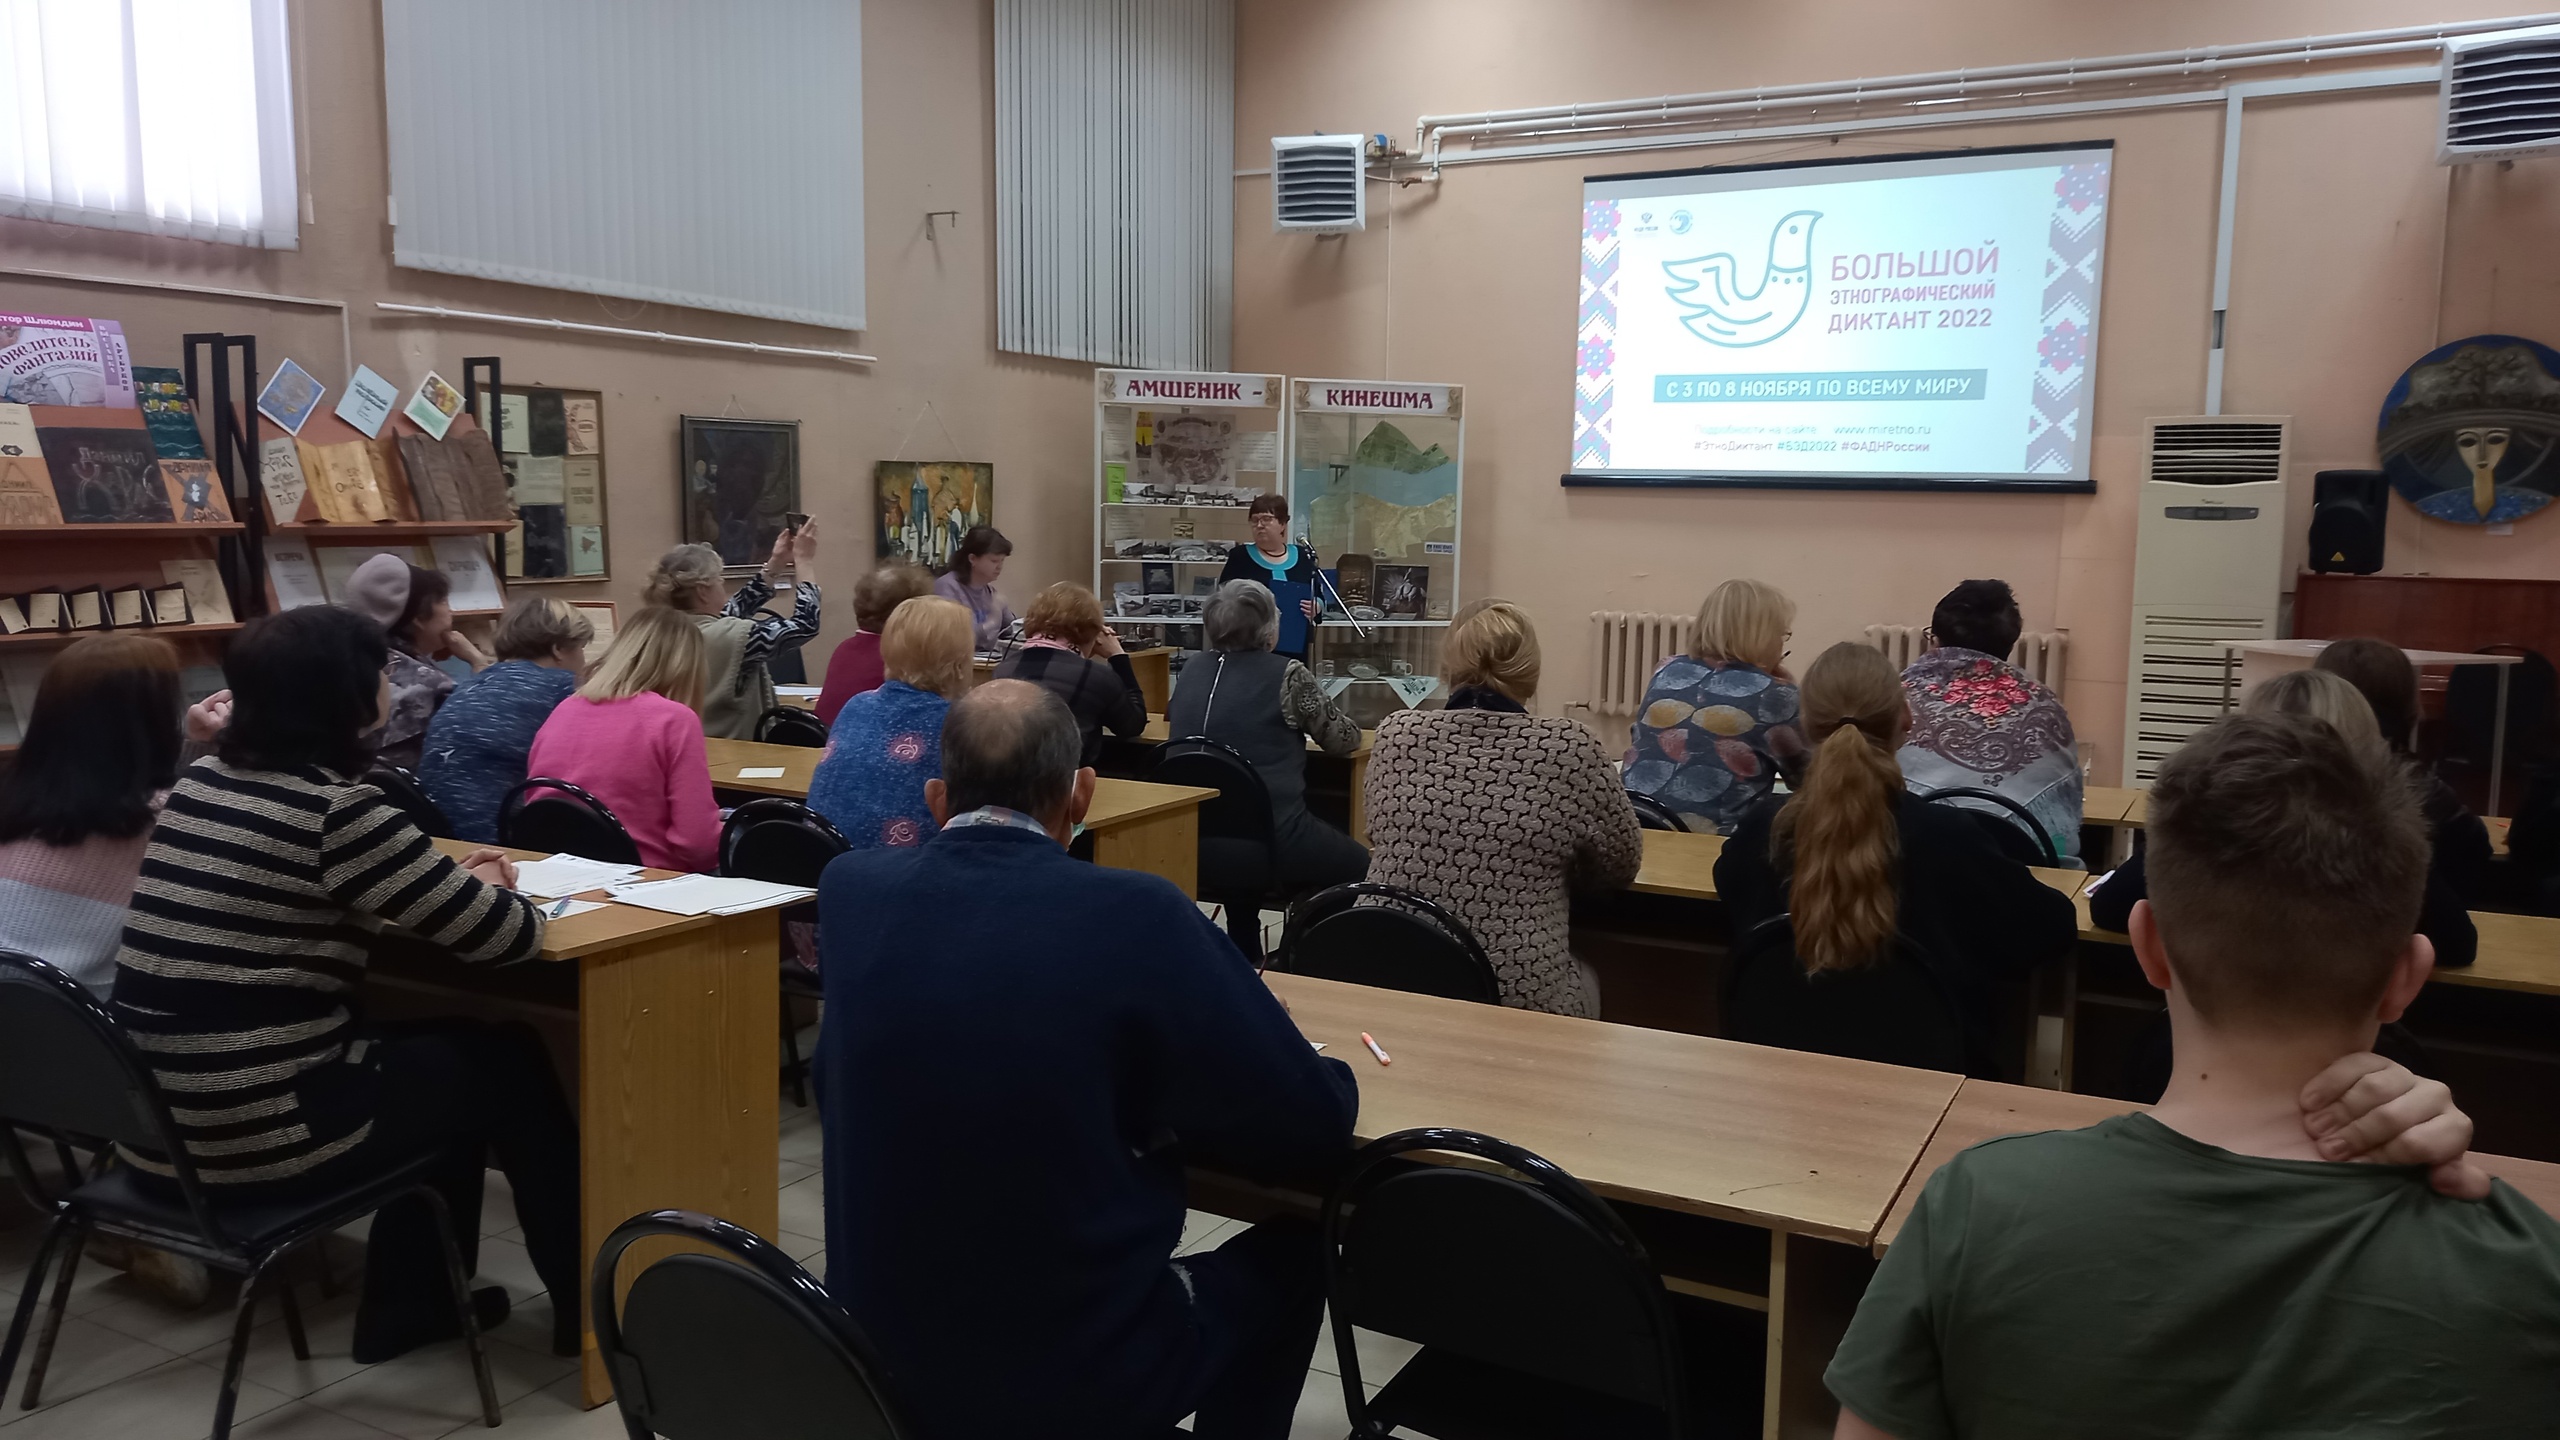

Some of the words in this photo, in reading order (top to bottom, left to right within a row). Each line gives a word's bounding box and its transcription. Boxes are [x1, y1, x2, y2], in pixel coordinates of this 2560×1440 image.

[1831, 239, 1999, 281] БОЛЬШОЙ
[1830, 279, 1996, 305] ЭТНОГРАФИЧЕСКИЙ
[1828, 310, 1931, 334] ДИКТАНТ
[1937, 308, 1992, 328] 2022
[1126, 380, 1241, 400] АМШЕНИК
[1666, 381, 1678, 398] С
[1682, 381, 1693, 398] 3
[1697, 381, 1721, 397] ПО
[1725, 381, 1736, 397] 8
[1740, 380, 1811, 397] НОЯБРЯ
[1816, 379, 1842, 396] ПО
[1846, 378, 1911, 395] ВСЕМУ
[1915, 377, 1972, 394] МИРУ
[1326, 389, 1433, 409] КИНЕШМА
[1694, 440, 1773, 452] #ЭтноДиктант
[1777, 440, 1837, 452] #БЭД2022
[1841, 440, 1930, 453] #ФАДНРоссии
